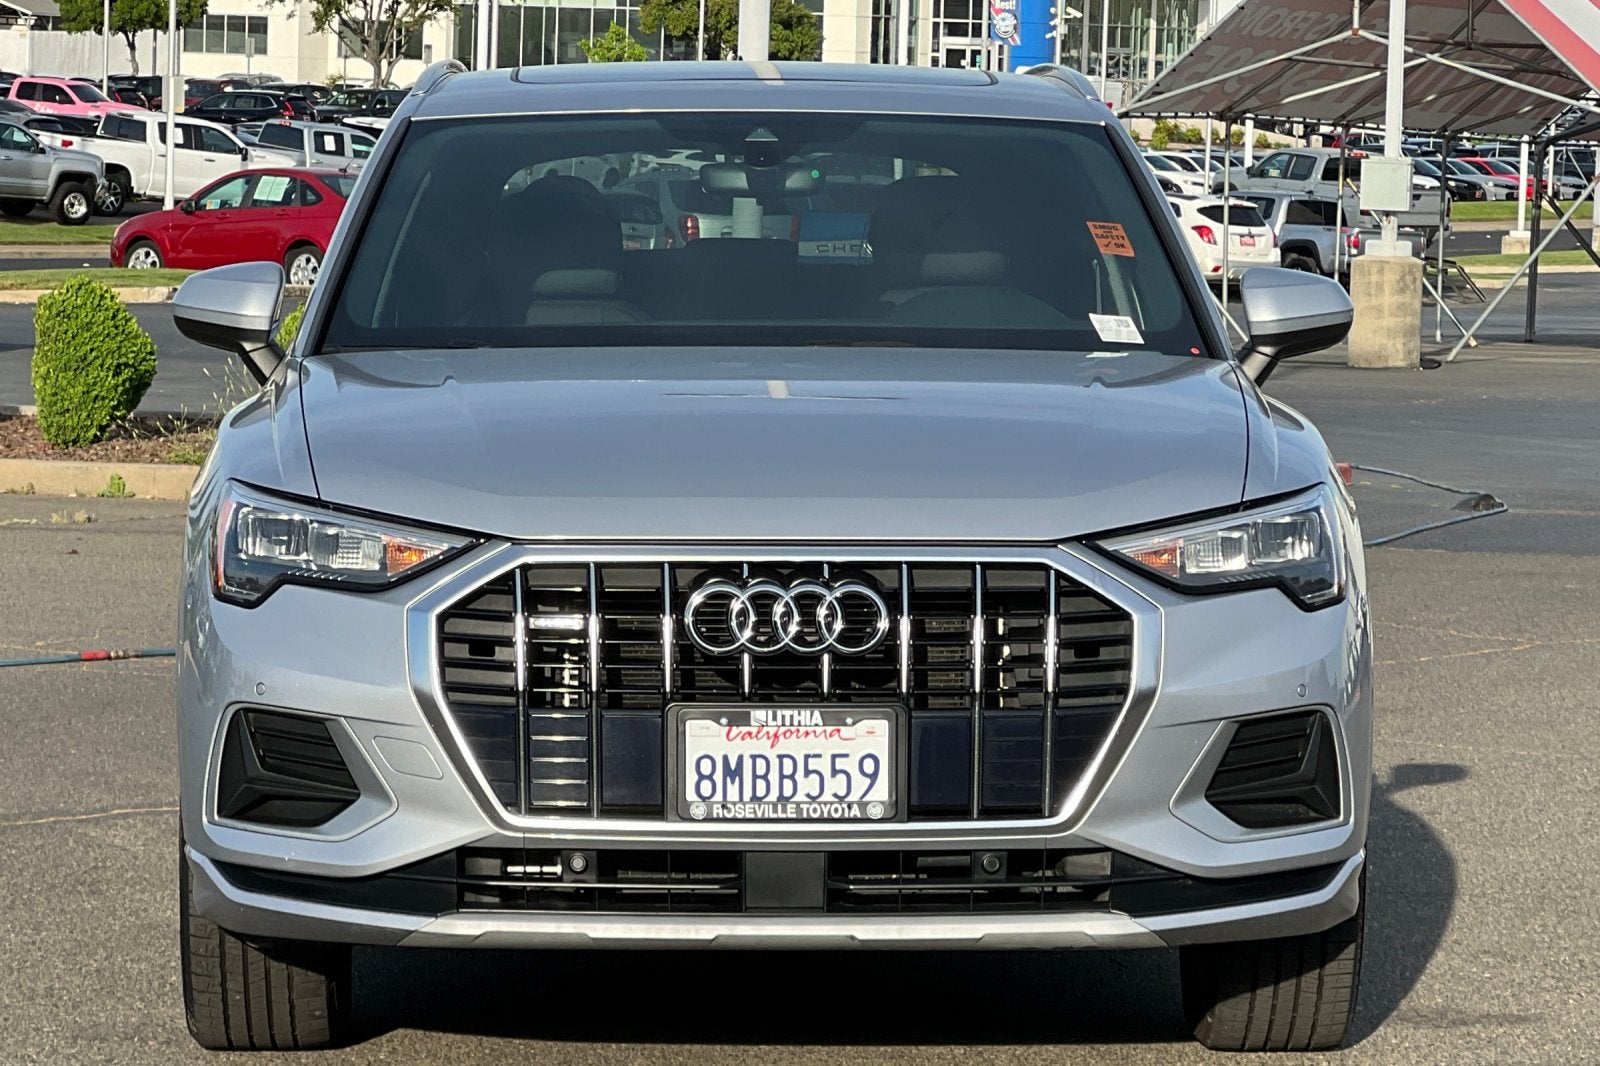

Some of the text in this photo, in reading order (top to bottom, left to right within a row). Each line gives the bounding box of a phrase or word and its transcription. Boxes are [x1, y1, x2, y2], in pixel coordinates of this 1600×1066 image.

[1092, 223, 1119, 231] SMOG
[1094, 233, 1126, 241] SAFETY
[767, 710, 824, 726] LITHIA
[725, 725, 856, 749] California
[694, 752, 881, 801] 8MBB559
[713, 803, 861, 818] ROSEVILLE TOYOTA
